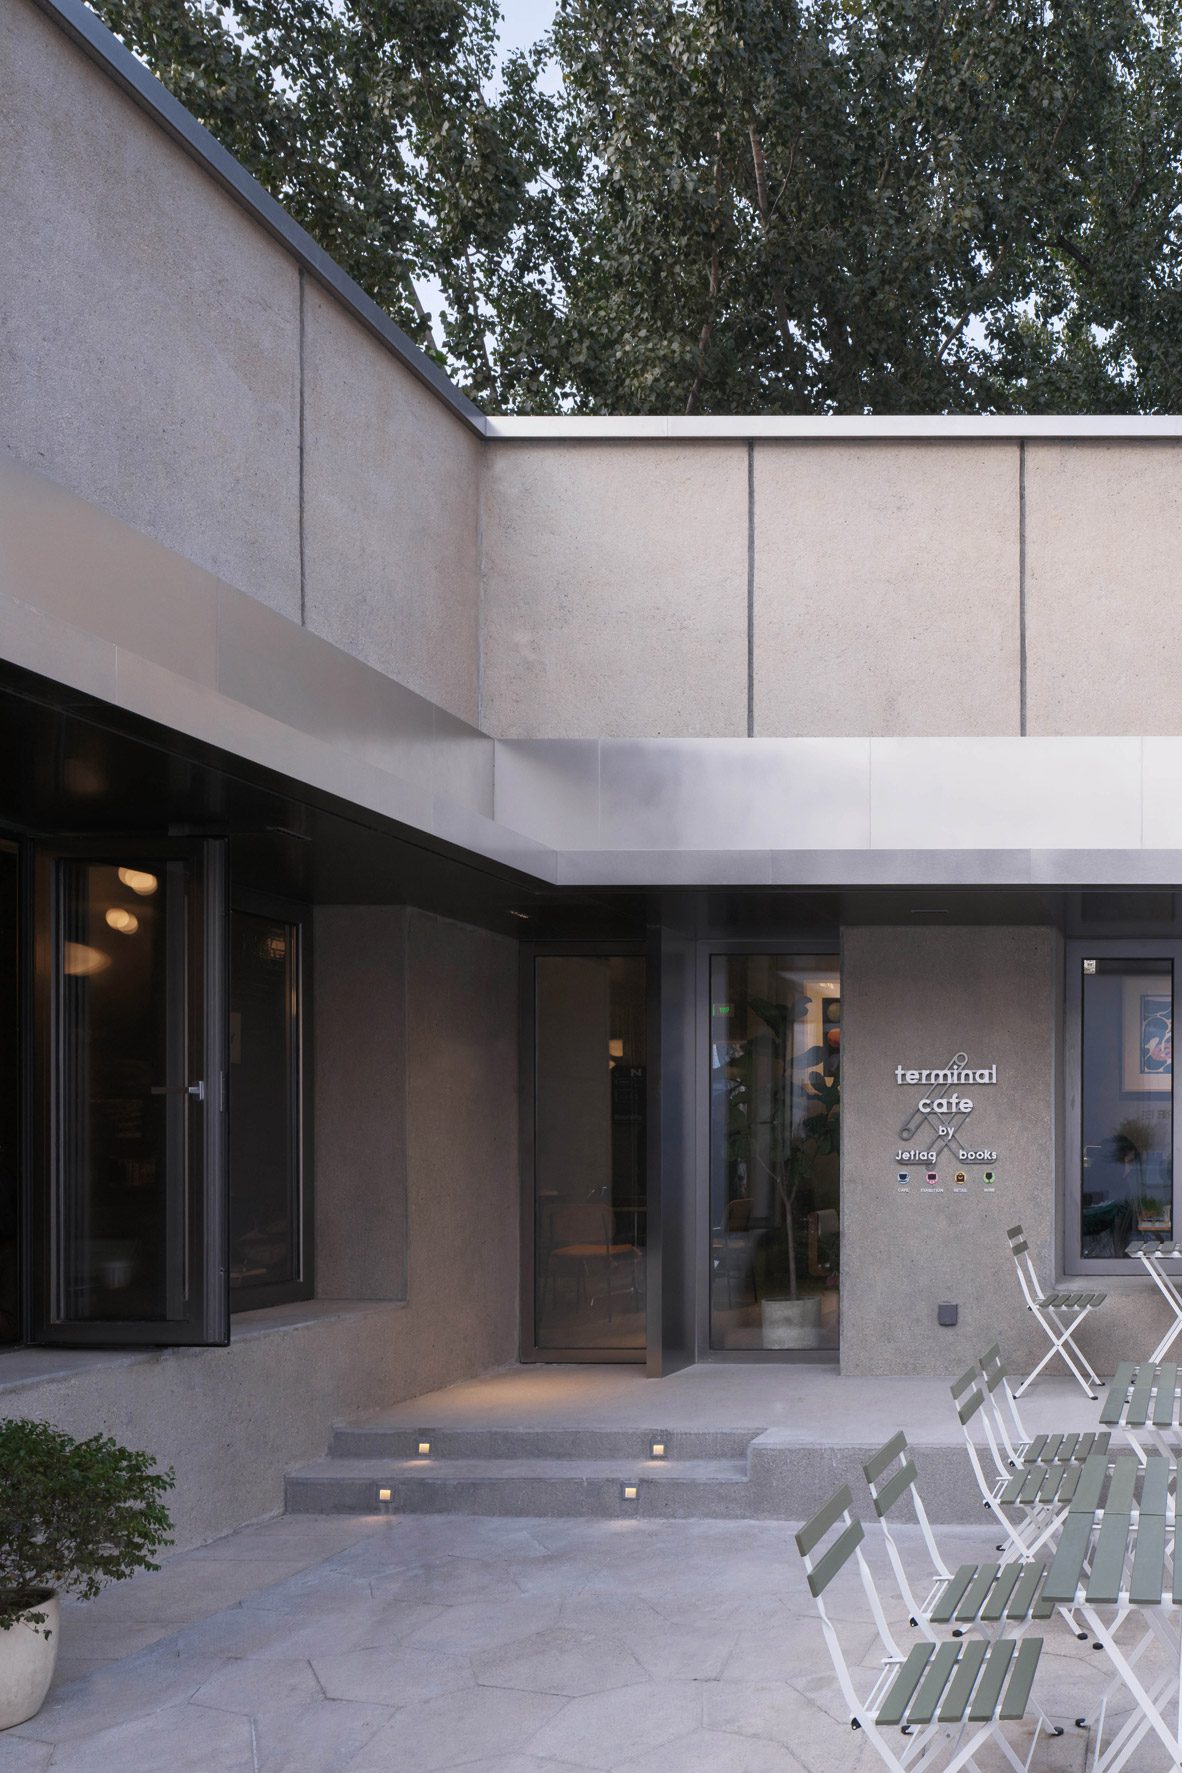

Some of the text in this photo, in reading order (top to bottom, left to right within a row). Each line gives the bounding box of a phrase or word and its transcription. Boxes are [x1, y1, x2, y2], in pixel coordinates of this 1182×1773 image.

[895, 1064, 997, 1084] terminal
[918, 1093, 974, 1112] cafe
[938, 1125, 954, 1139] by
[895, 1149, 997, 1163] Jetlag books
